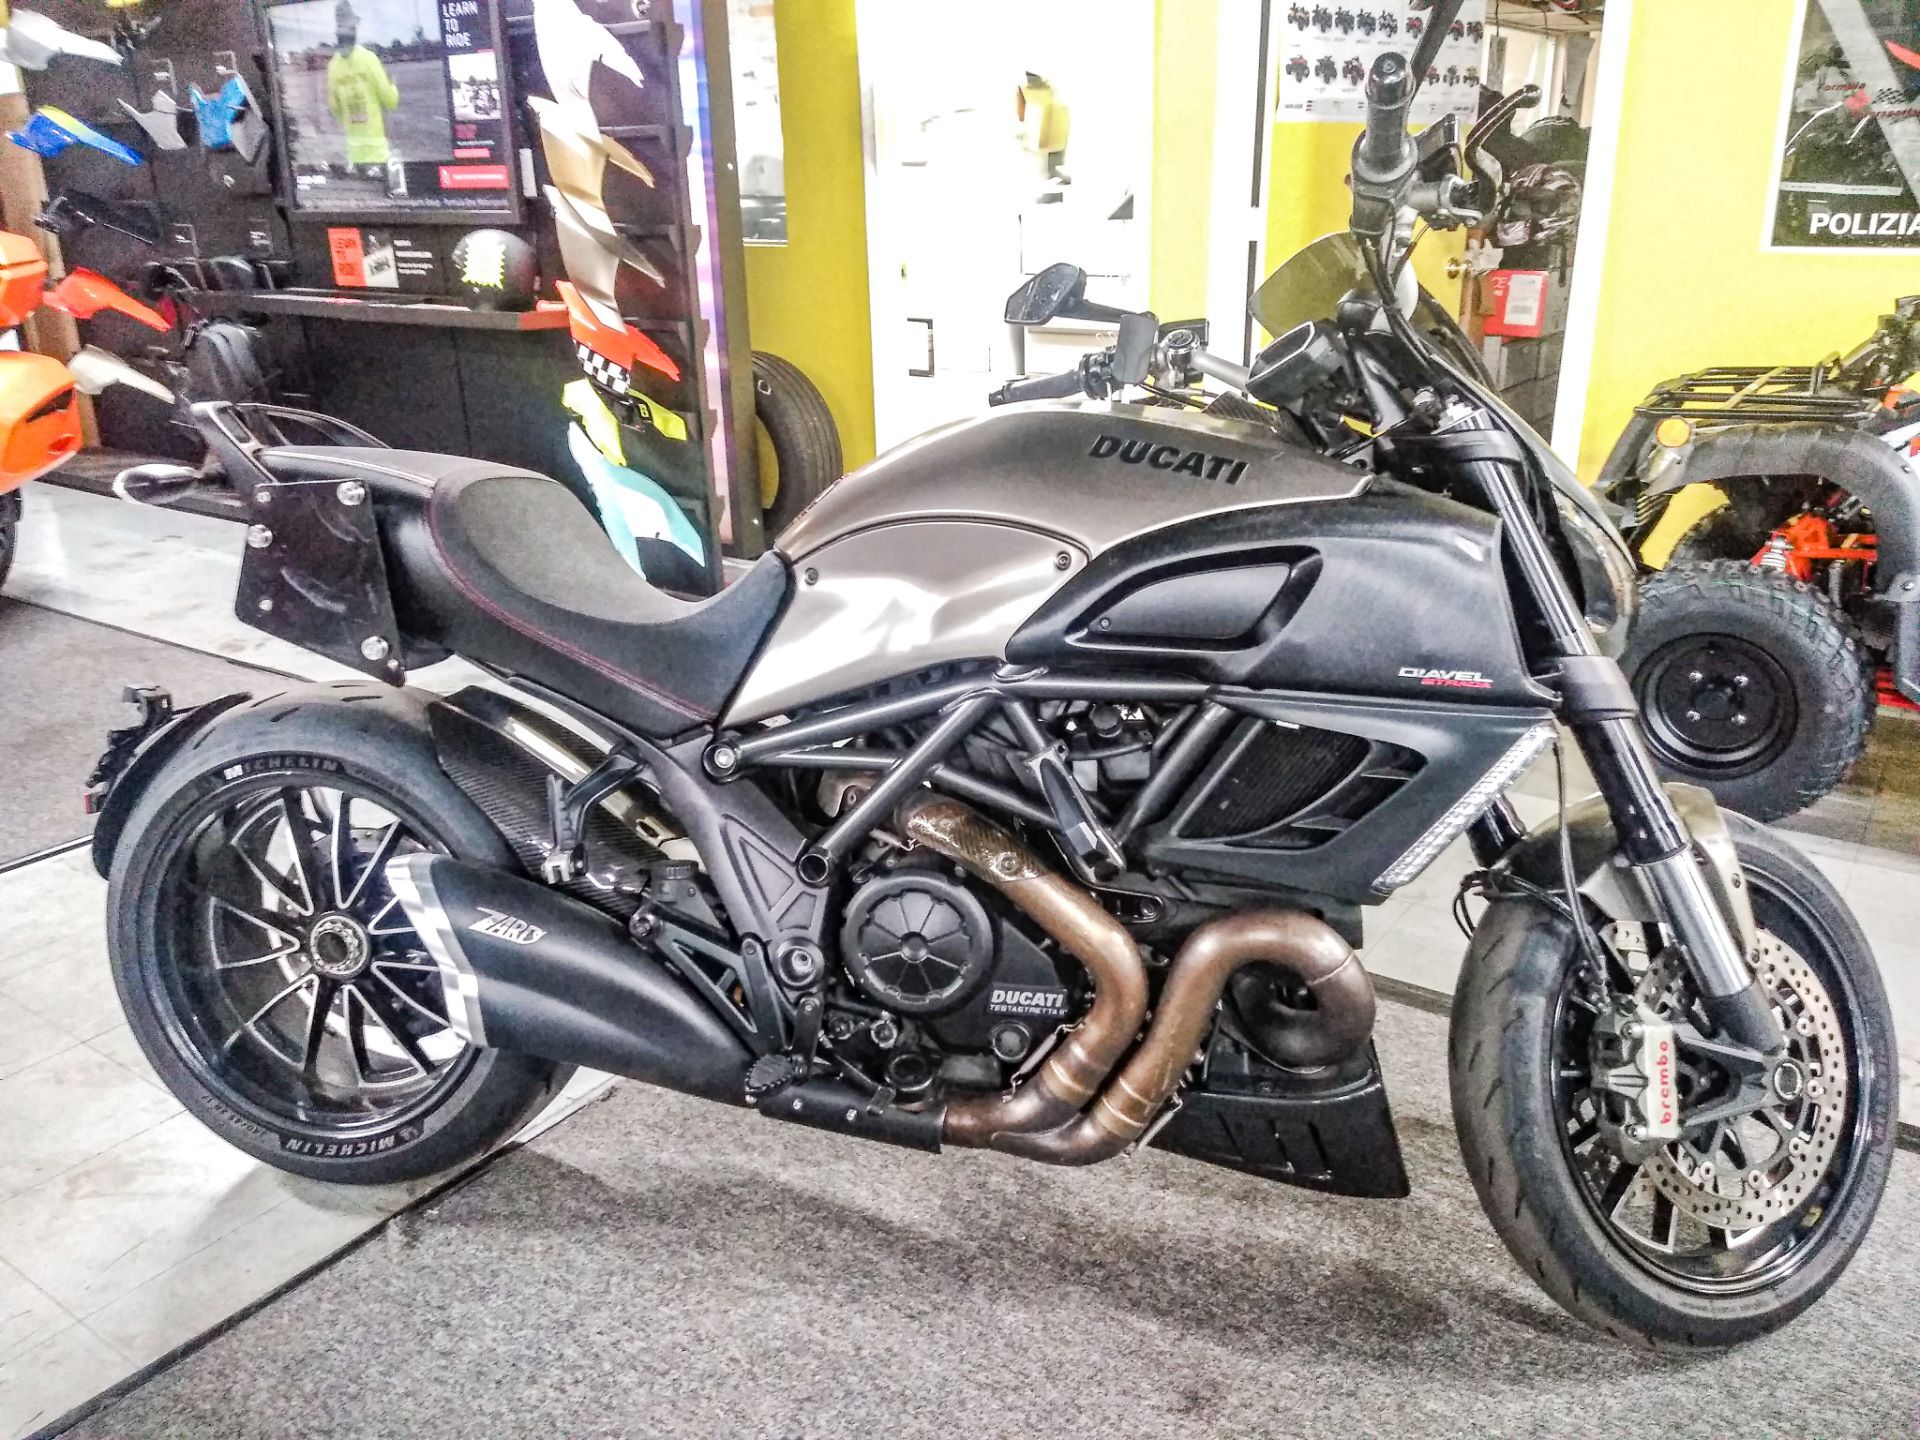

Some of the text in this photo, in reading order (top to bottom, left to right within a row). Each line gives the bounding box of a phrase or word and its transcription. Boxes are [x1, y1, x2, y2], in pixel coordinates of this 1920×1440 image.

[442, 1, 478, 18] LEARN
[444, 18, 460, 32] TO
[445, 32, 473, 48] RIDE
[1088, 434, 1249, 485] DUCATI
[1397, 667, 1494, 683] DIAVEL
[225, 756, 338, 778] ICHELIN
[467, 906, 548, 945] ZARD
[991, 989, 1064, 1008] DUCATI
[1656, 1041, 1672, 1125] brembo
[286, 1135, 396, 1156] MICHELIN
